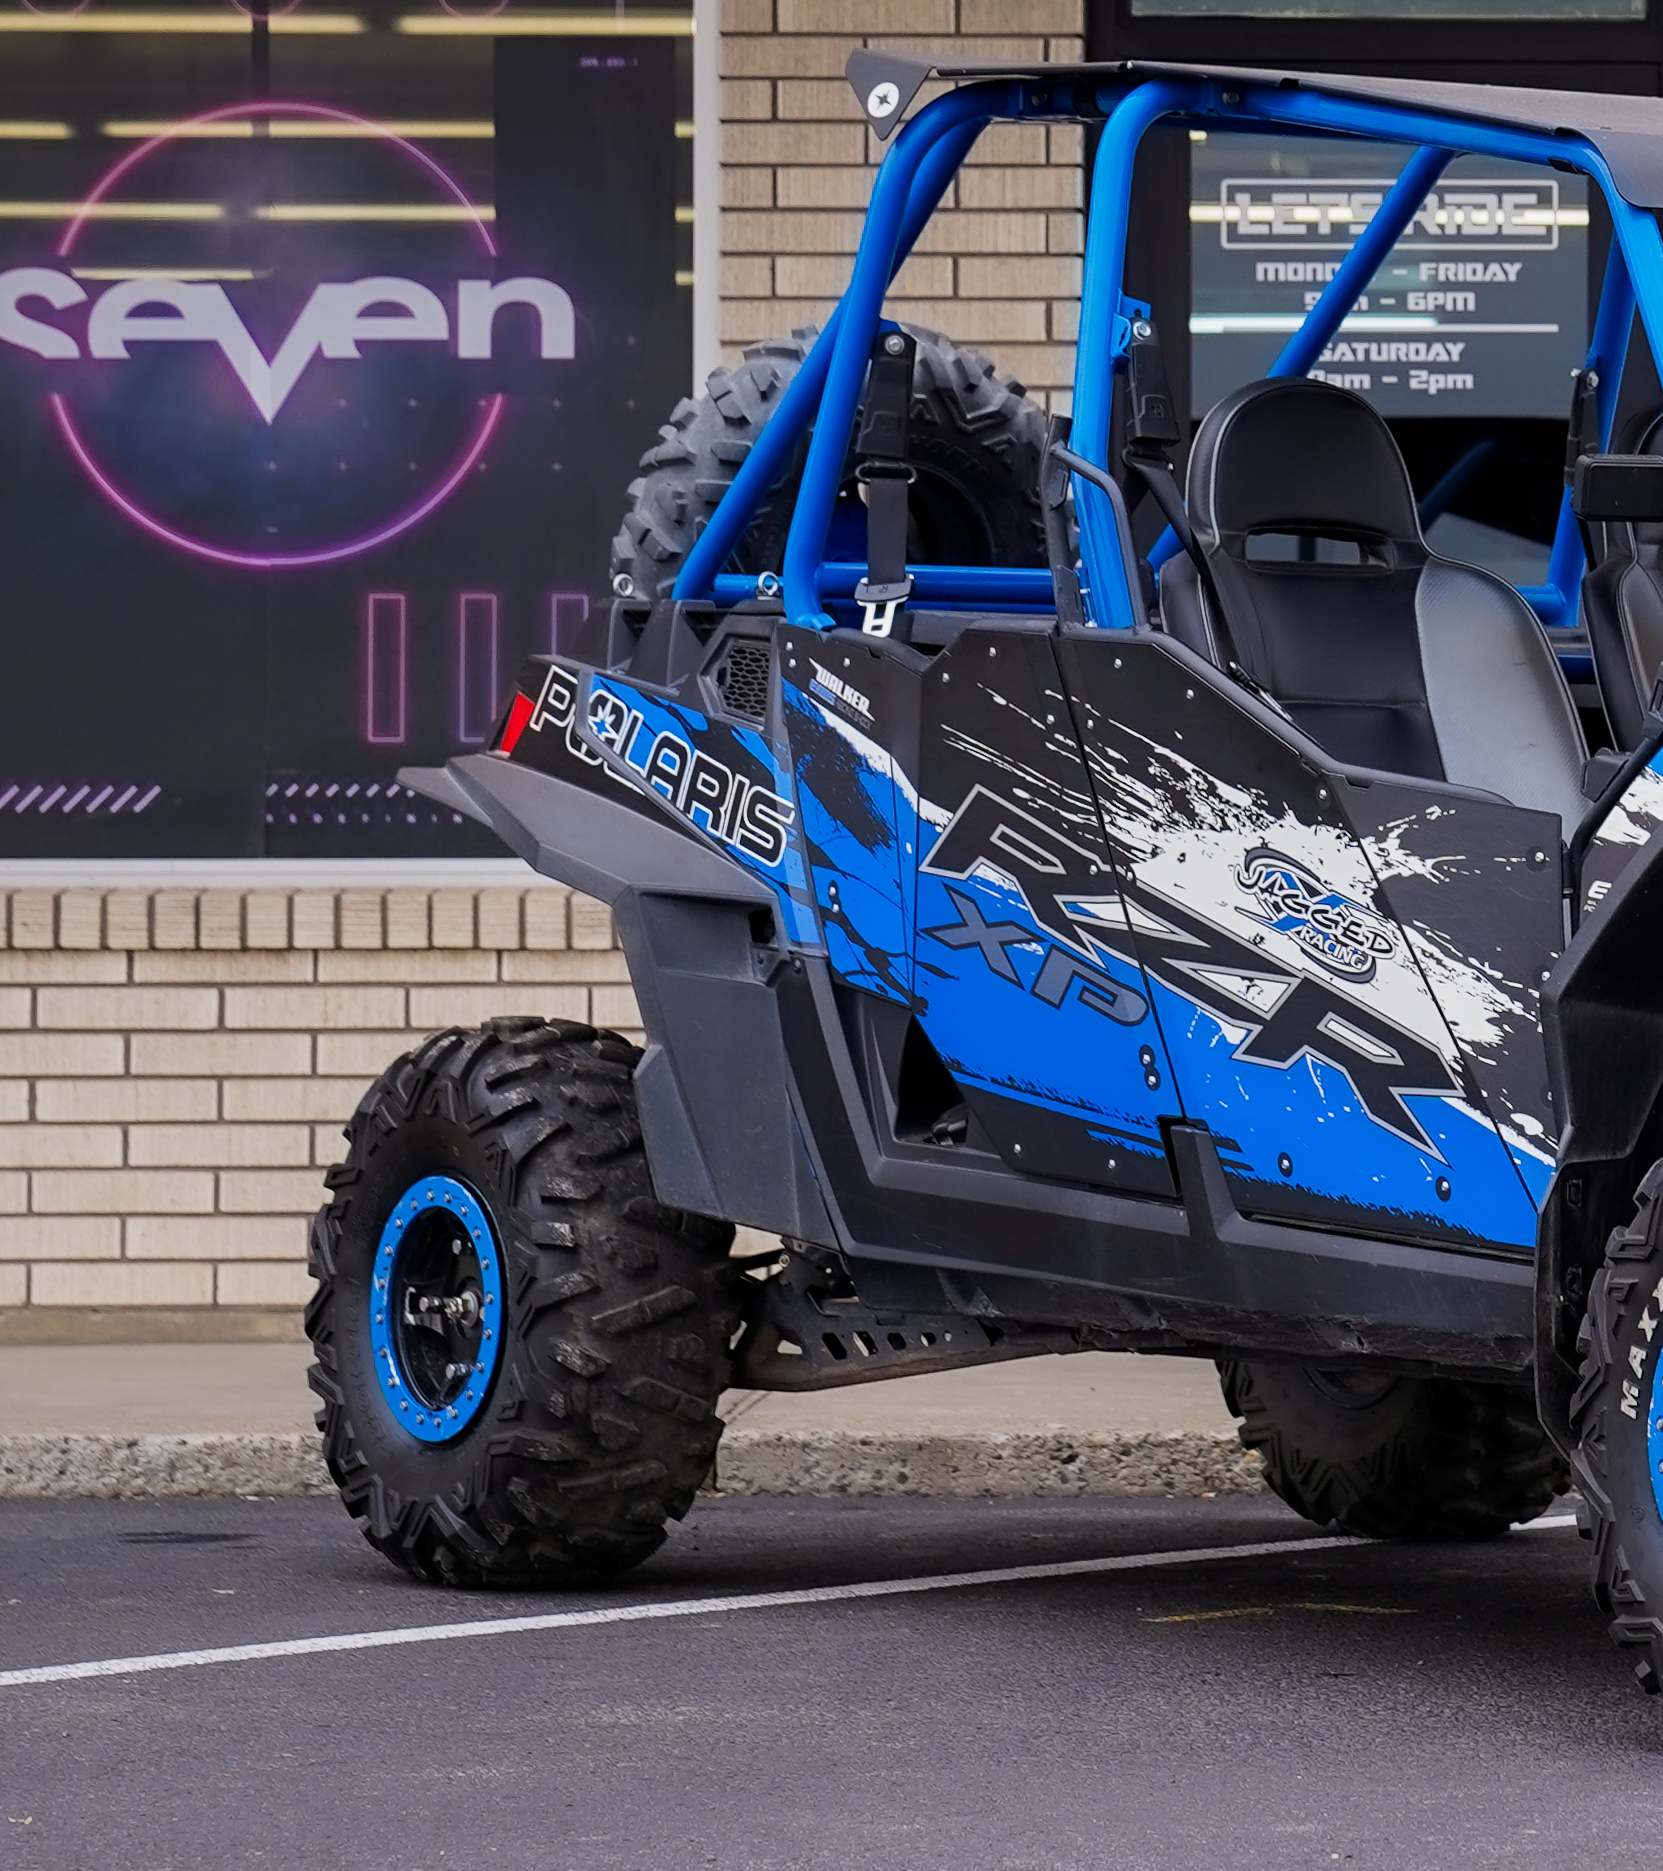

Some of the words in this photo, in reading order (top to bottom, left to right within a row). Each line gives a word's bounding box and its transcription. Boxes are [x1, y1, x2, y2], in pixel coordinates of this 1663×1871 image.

[1419, 262, 1523, 283] FRIDAY
[1406, 291, 1476, 312] 6PM
[1408, 369, 1475, 394] 2pm
[808, 657, 876, 722] WALKER
[529, 664, 796, 868] POLARIS
[921, 882, 1151, 1026] XP
[1300, 926, 1365, 970] RACING
